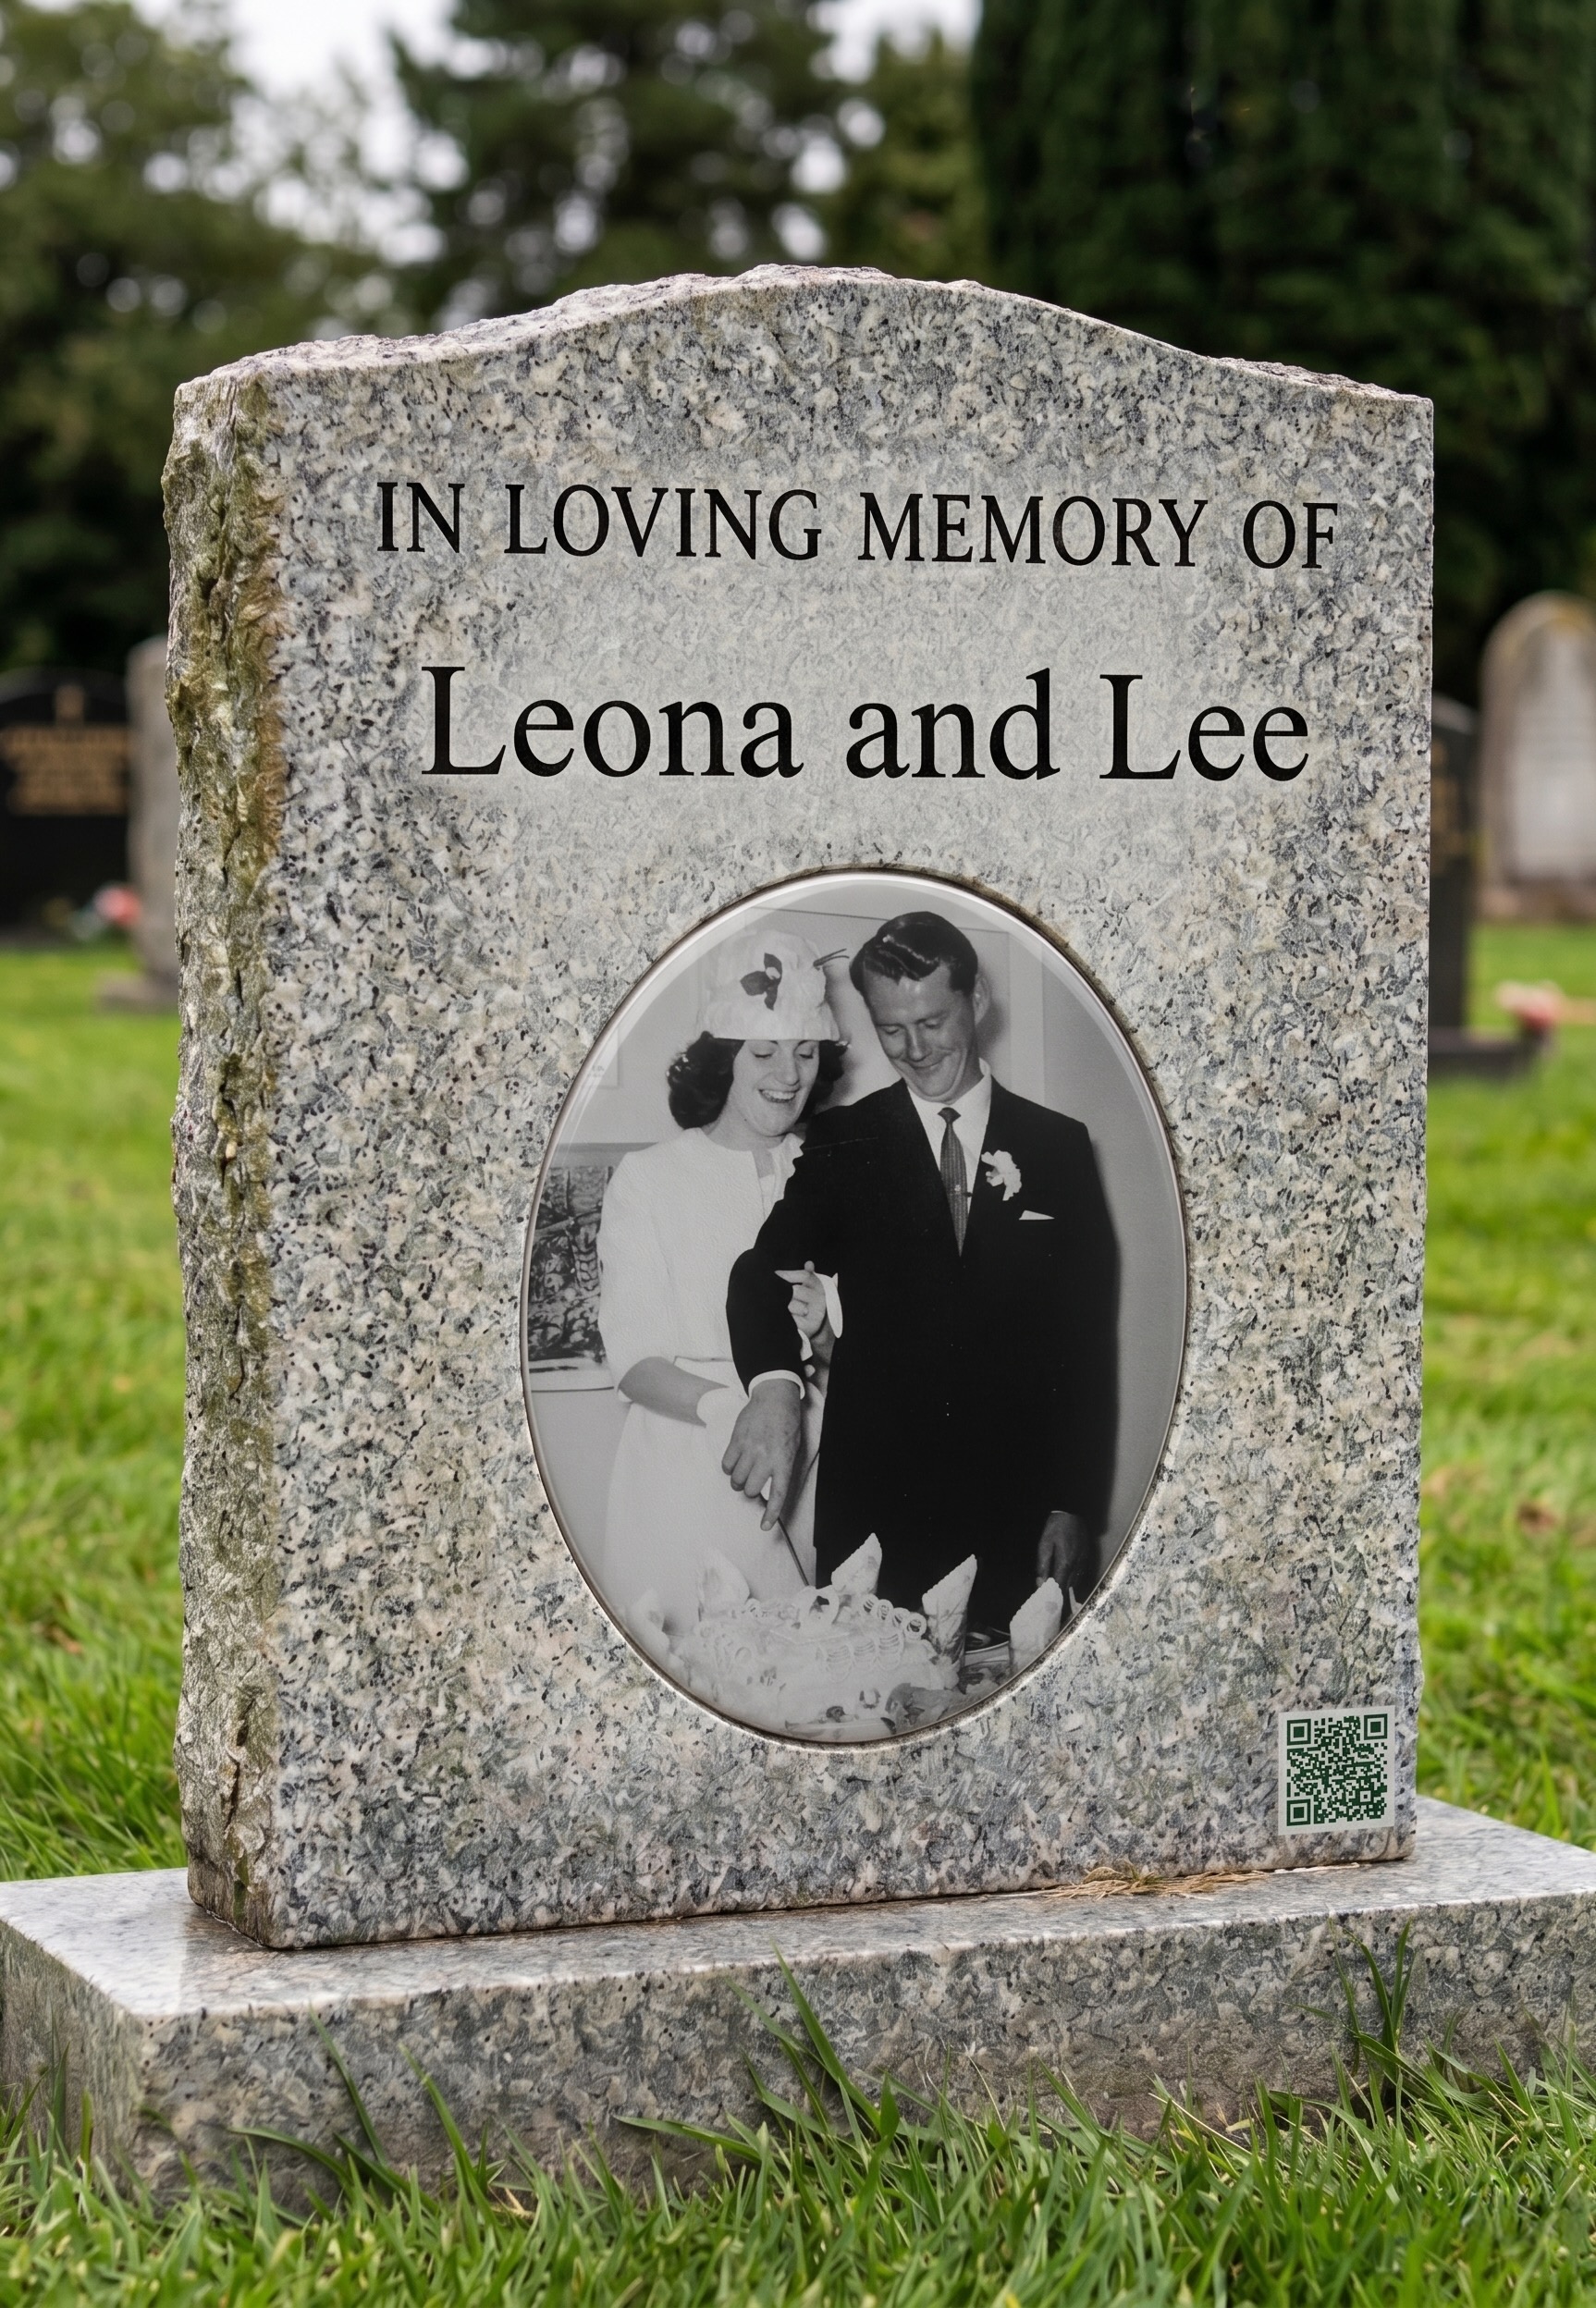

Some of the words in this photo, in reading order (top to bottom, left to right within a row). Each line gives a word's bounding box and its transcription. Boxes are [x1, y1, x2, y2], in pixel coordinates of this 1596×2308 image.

[375, 481, 466, 555] IN
[503, 483, 823, 561] LOVING
[857, 491, 1209, 568] MEMORY
[1242, 499, 1339, 571] OF
[420, 665, 805, 780] Leona
[845, 667, 1062, 781] and
[1099, 673, 1310, 782] Lee
